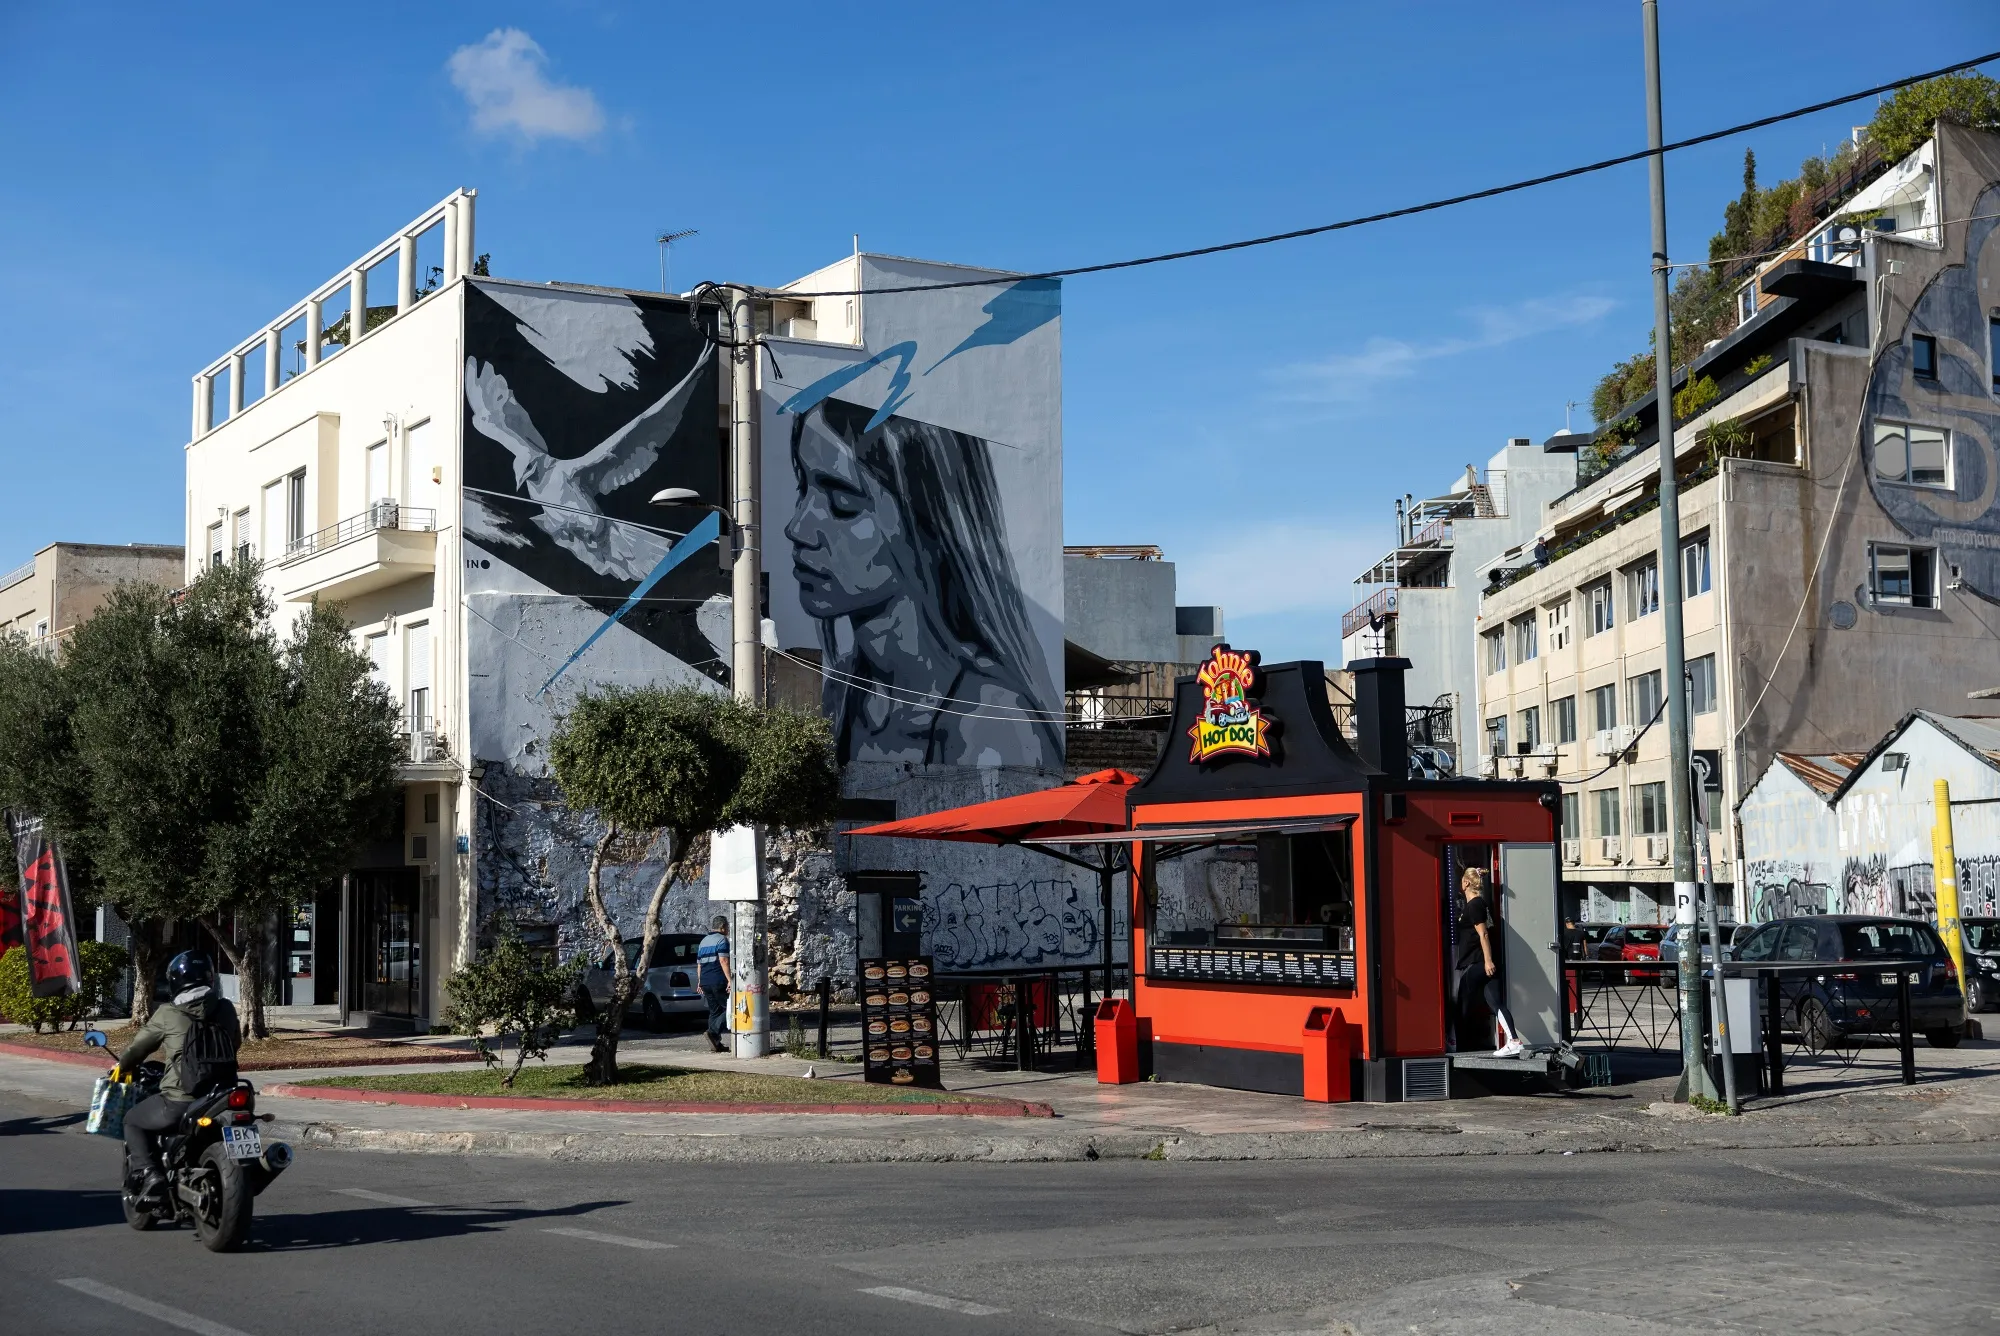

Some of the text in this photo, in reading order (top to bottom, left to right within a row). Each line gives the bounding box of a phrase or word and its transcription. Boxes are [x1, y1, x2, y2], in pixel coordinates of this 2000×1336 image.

[1197, 645, 1254, 698] Johnie
[1202, 726, 1255, 748] HOT DOG
[894, 904, 923, 912] PARKING
[237, 1142, 261, 1155] 129
